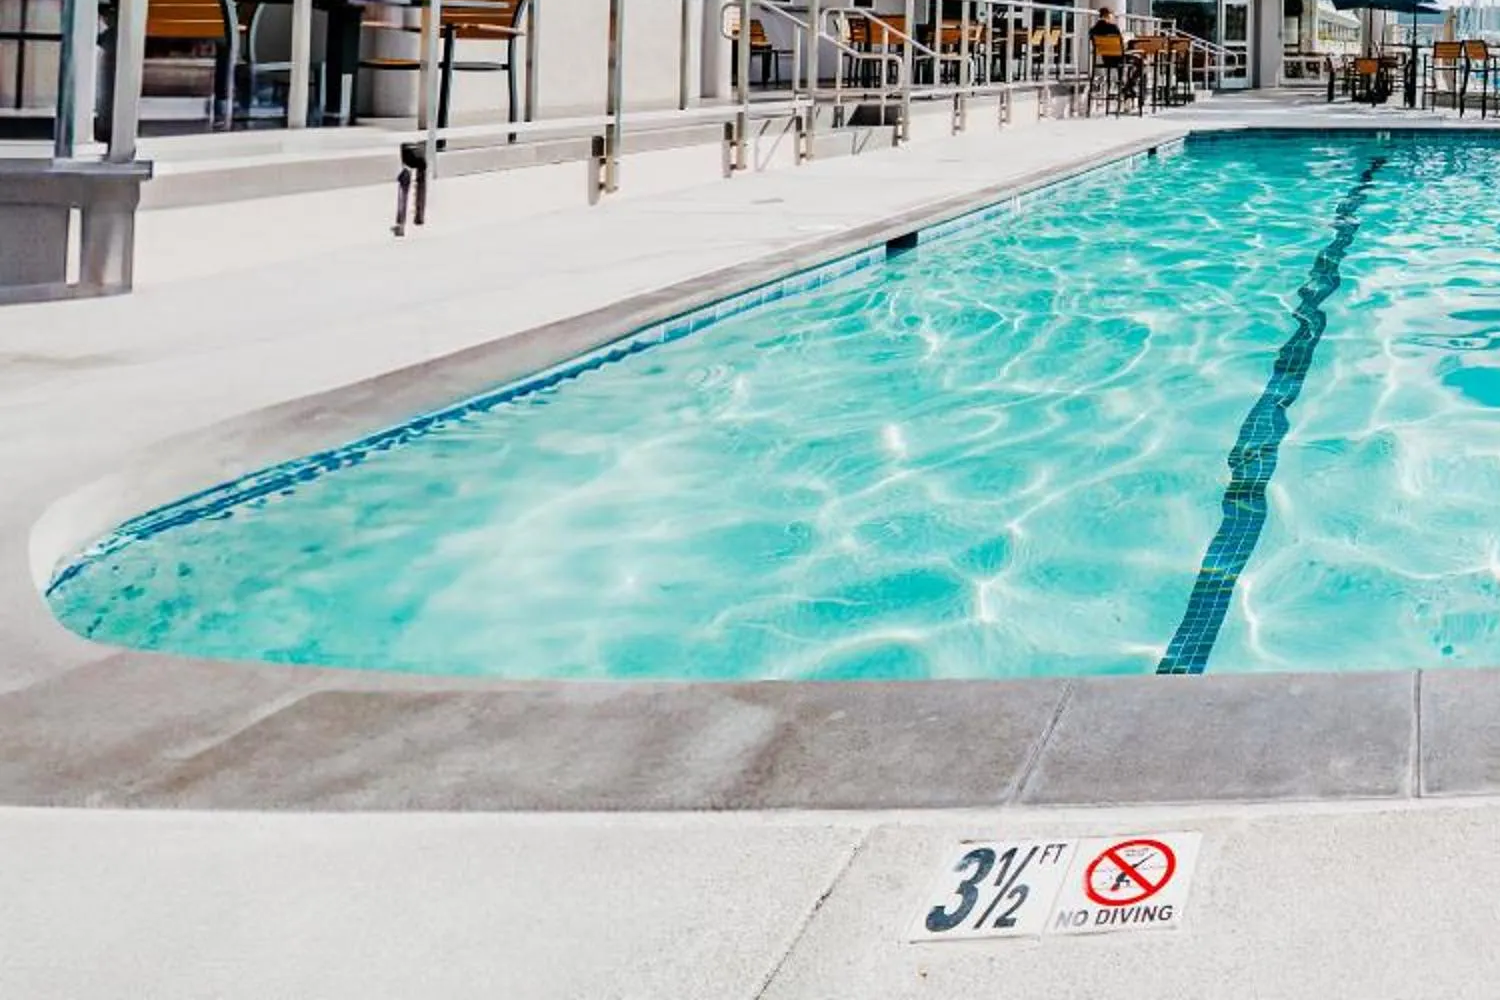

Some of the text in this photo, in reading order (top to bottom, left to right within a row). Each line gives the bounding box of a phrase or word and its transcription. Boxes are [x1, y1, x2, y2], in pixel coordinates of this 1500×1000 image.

[1039, 844, 1067, 864] FT
[1055, 905, 1173, 929] NO DIVING
